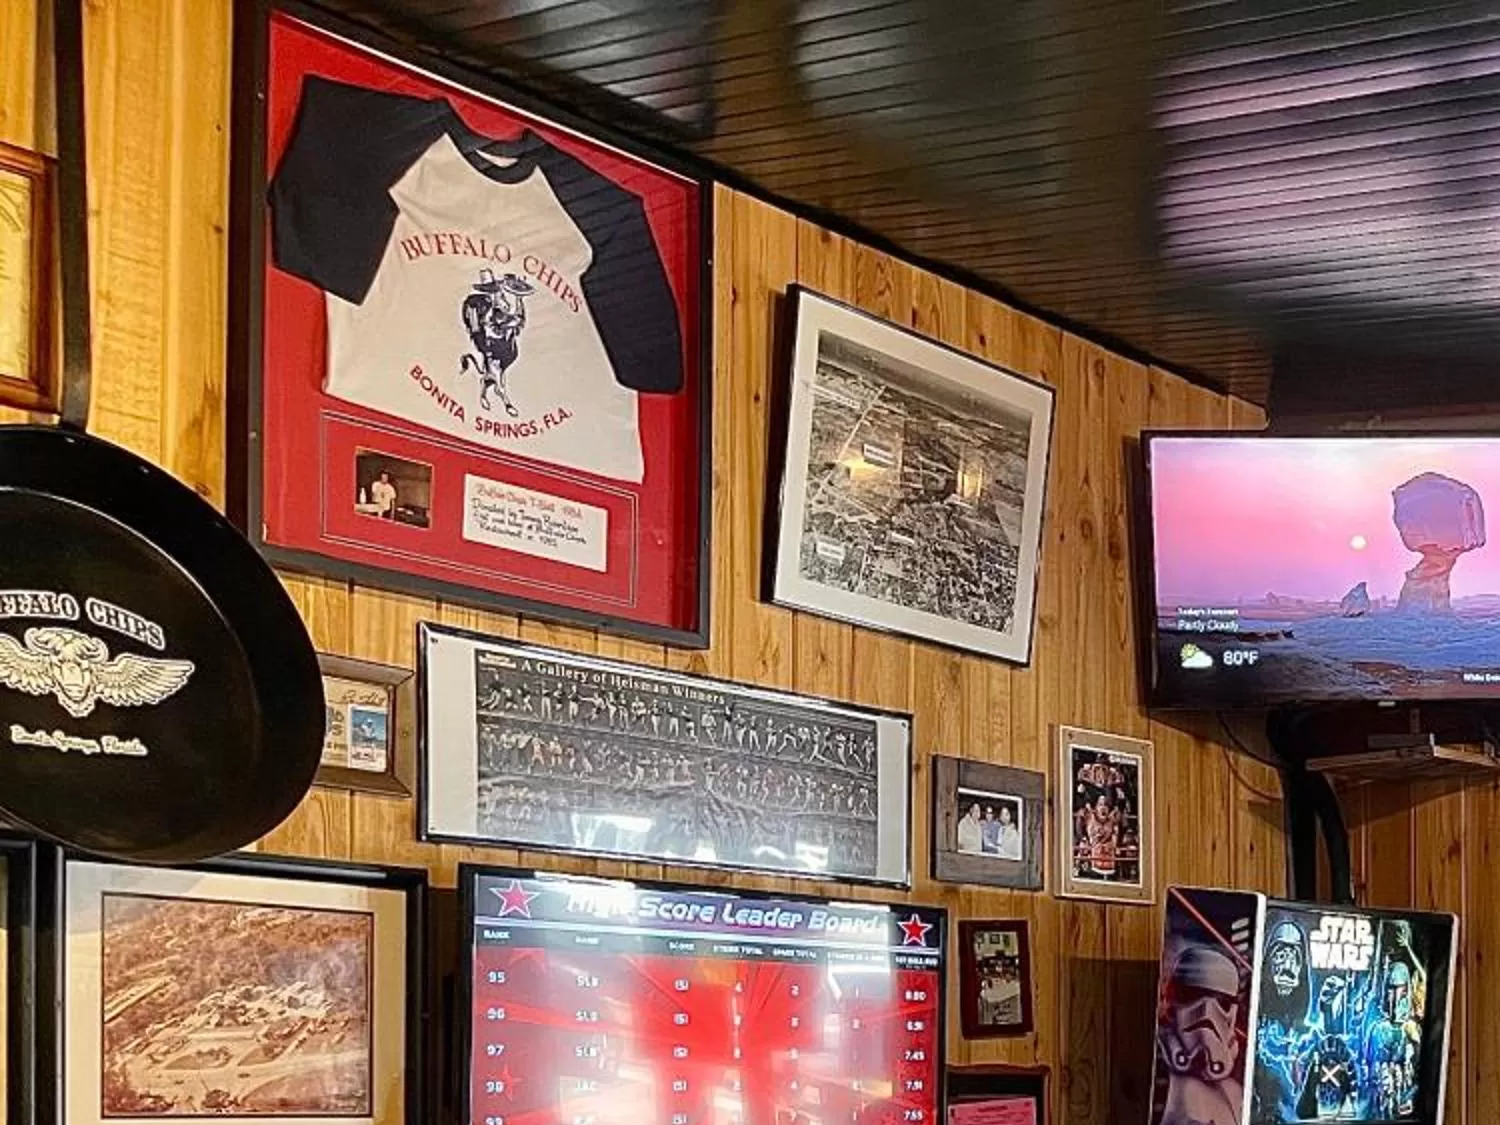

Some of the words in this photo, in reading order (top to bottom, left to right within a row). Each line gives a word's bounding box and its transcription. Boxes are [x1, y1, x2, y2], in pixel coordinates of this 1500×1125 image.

[401, 232, 512, 263] BUFFALO
[522, 254, 583, 314] CHIPS
[409, 364, 467, 423] BONITA
[543, 406, 573, 428] FLA.
[86, 597, 166, 650] CHIPS
[536, 660, 589, 685] Gallery
[592, 671, 606, 684] of
[671, 684, 726, 705] Winners
[638, 895, 716, 924] Score
[721, 902, 804, 930] Leader
[1309, 915, 1375, 946] STAR
[1310, 942, 1375, 971] WARS
